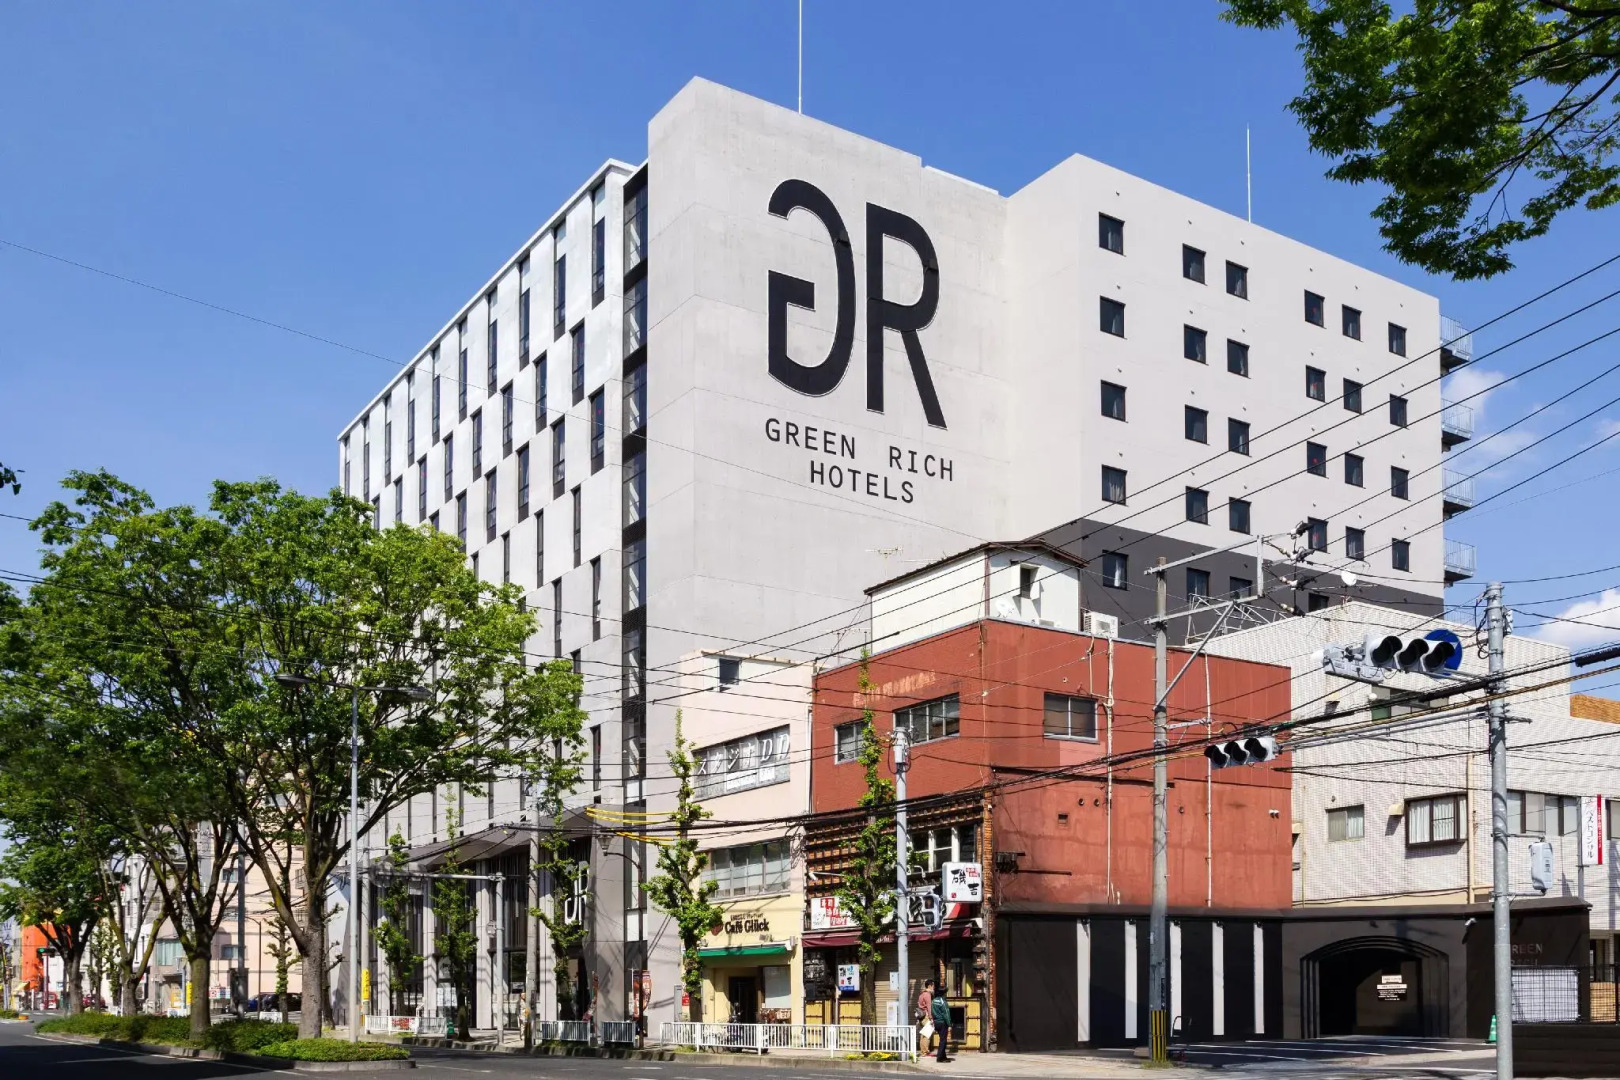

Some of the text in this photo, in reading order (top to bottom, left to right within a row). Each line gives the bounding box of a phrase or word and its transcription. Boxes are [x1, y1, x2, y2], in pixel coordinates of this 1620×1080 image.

[765, 418, 953, 481] GREEN RICH
[810, 460, 914, 503] HOTELS
[725, 918, 770, 934] Café Glück
[1511, 943, 1543, 954] REEN
